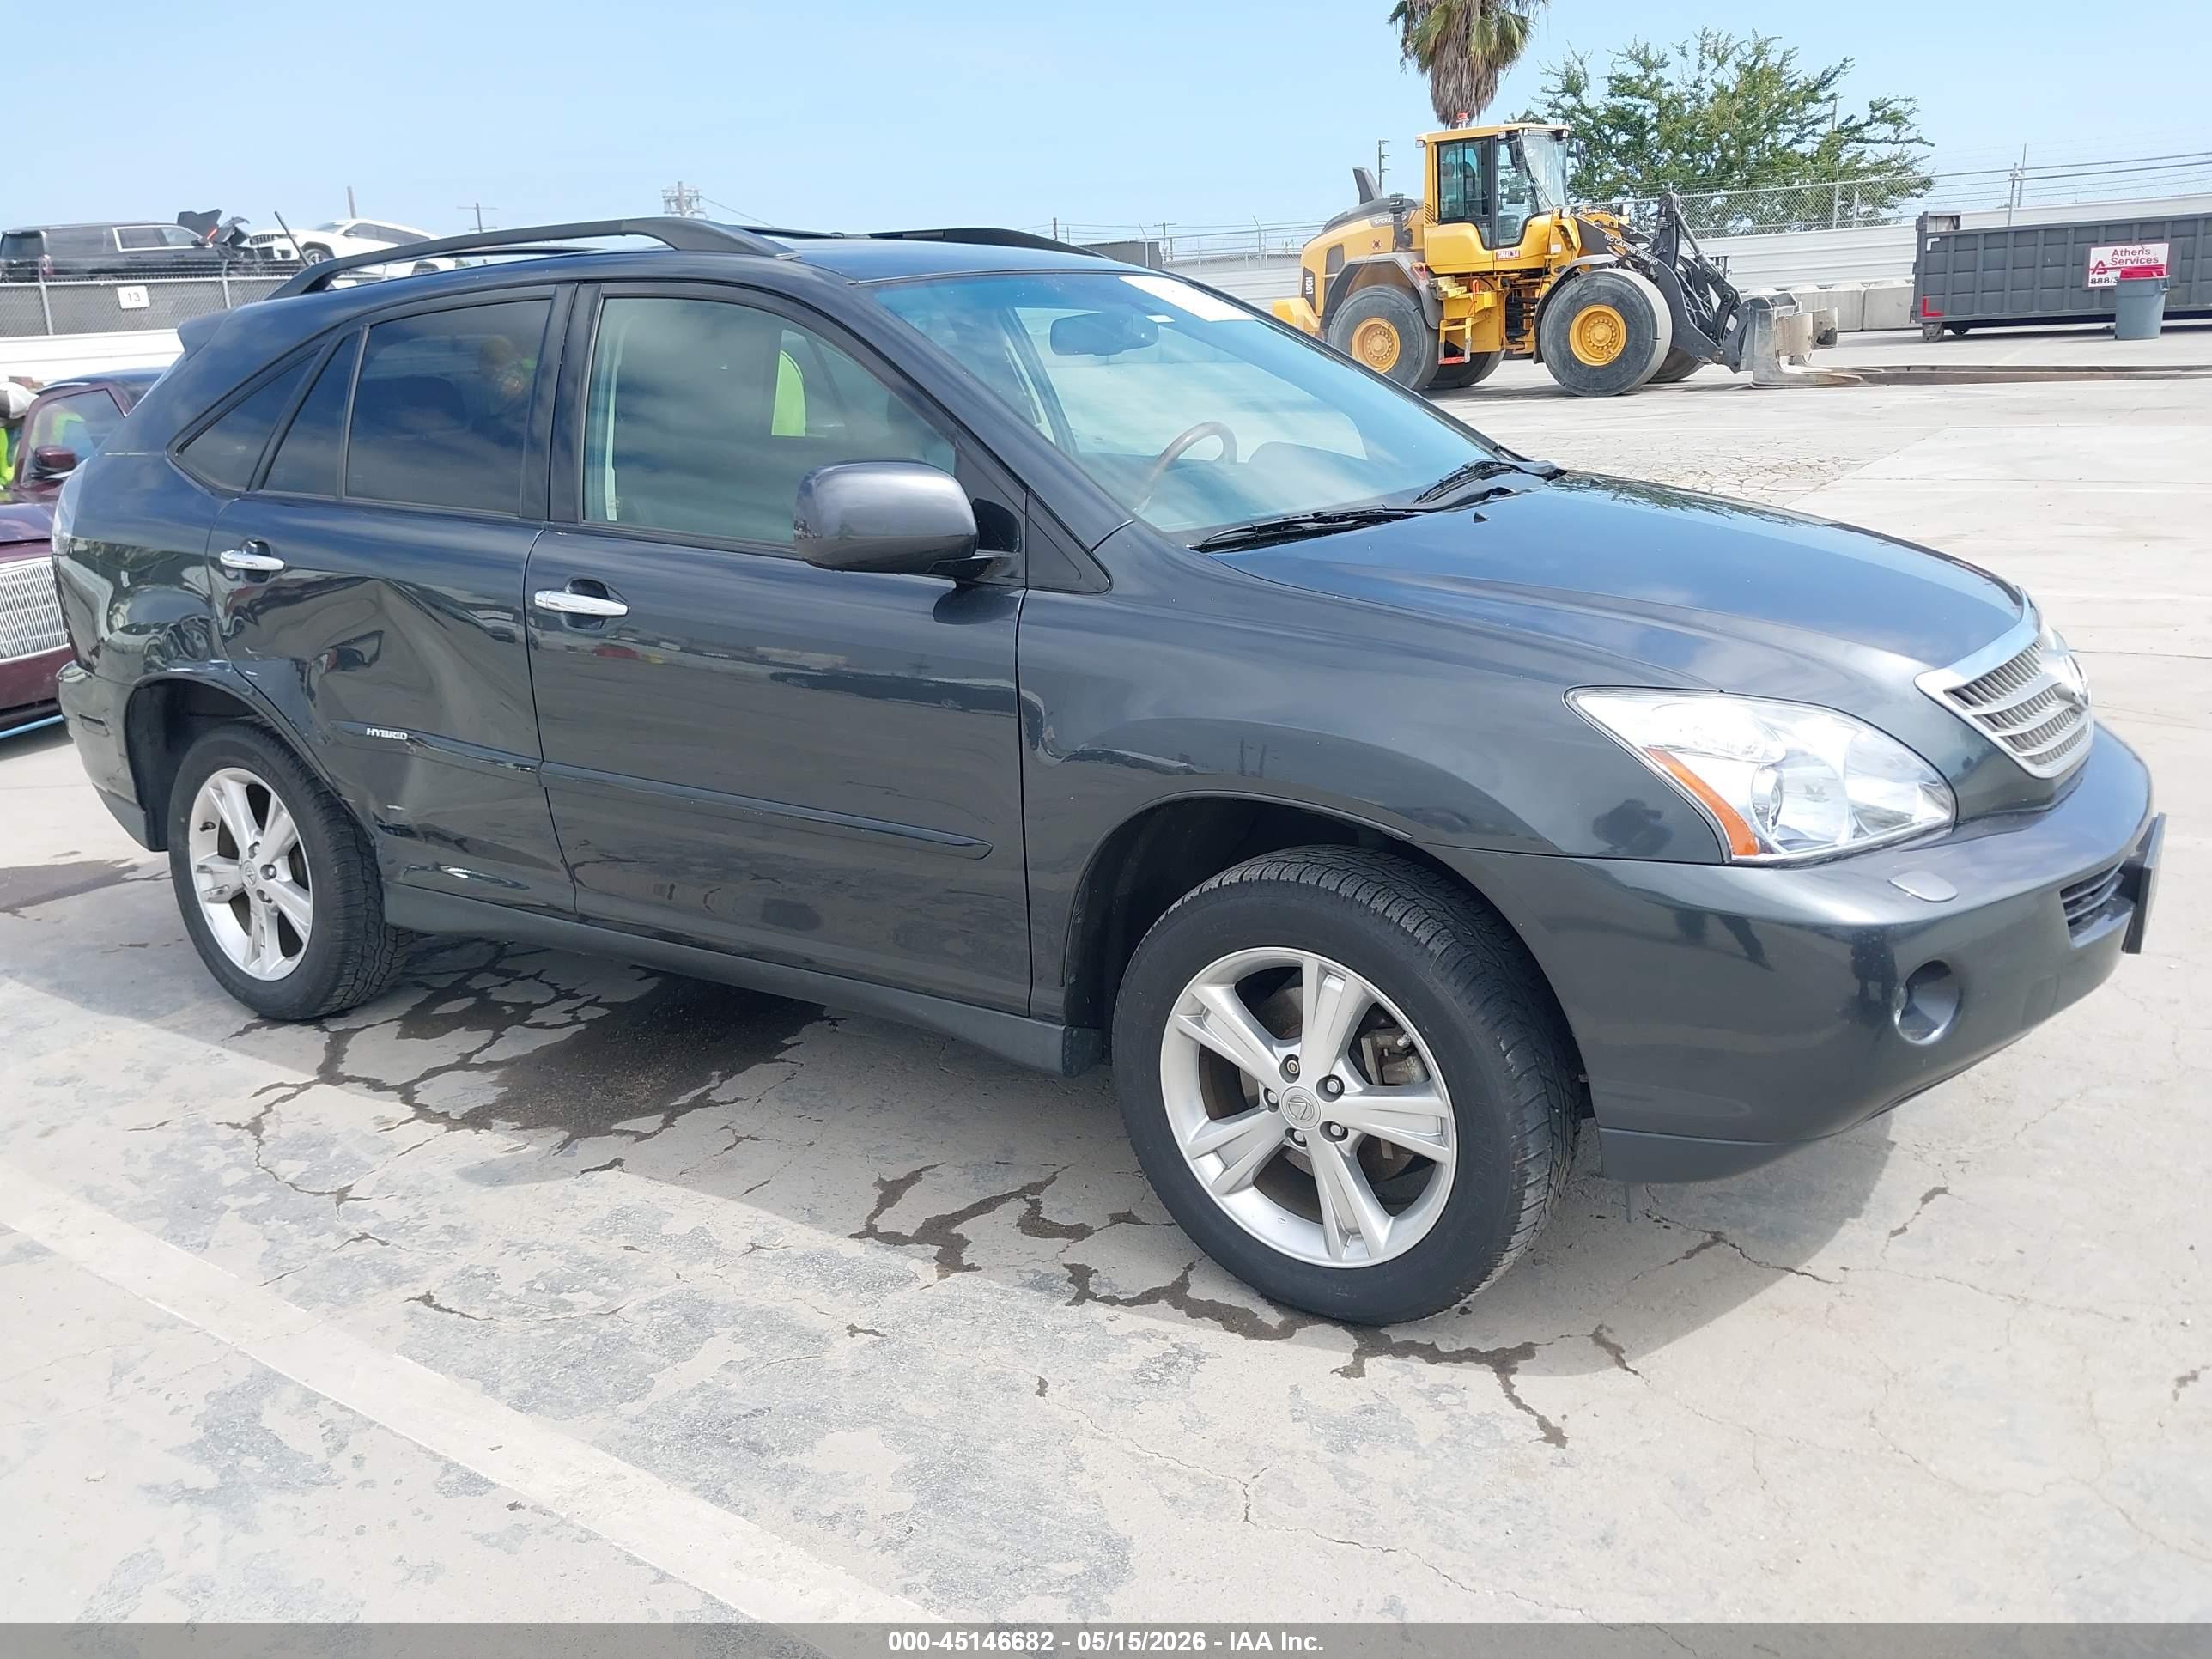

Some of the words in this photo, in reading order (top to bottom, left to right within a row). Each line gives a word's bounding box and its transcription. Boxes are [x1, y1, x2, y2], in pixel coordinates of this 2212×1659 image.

[1374, 215, 1407, 224] VOLO
[2112, 248, 2151, 257] Athens
[2110, 257, 2160, 266] Services
[1305, 276, 1314, 295] L90H
[127, 292, 141, 302] 13
[366, 727, 408, 740] HYBRID
